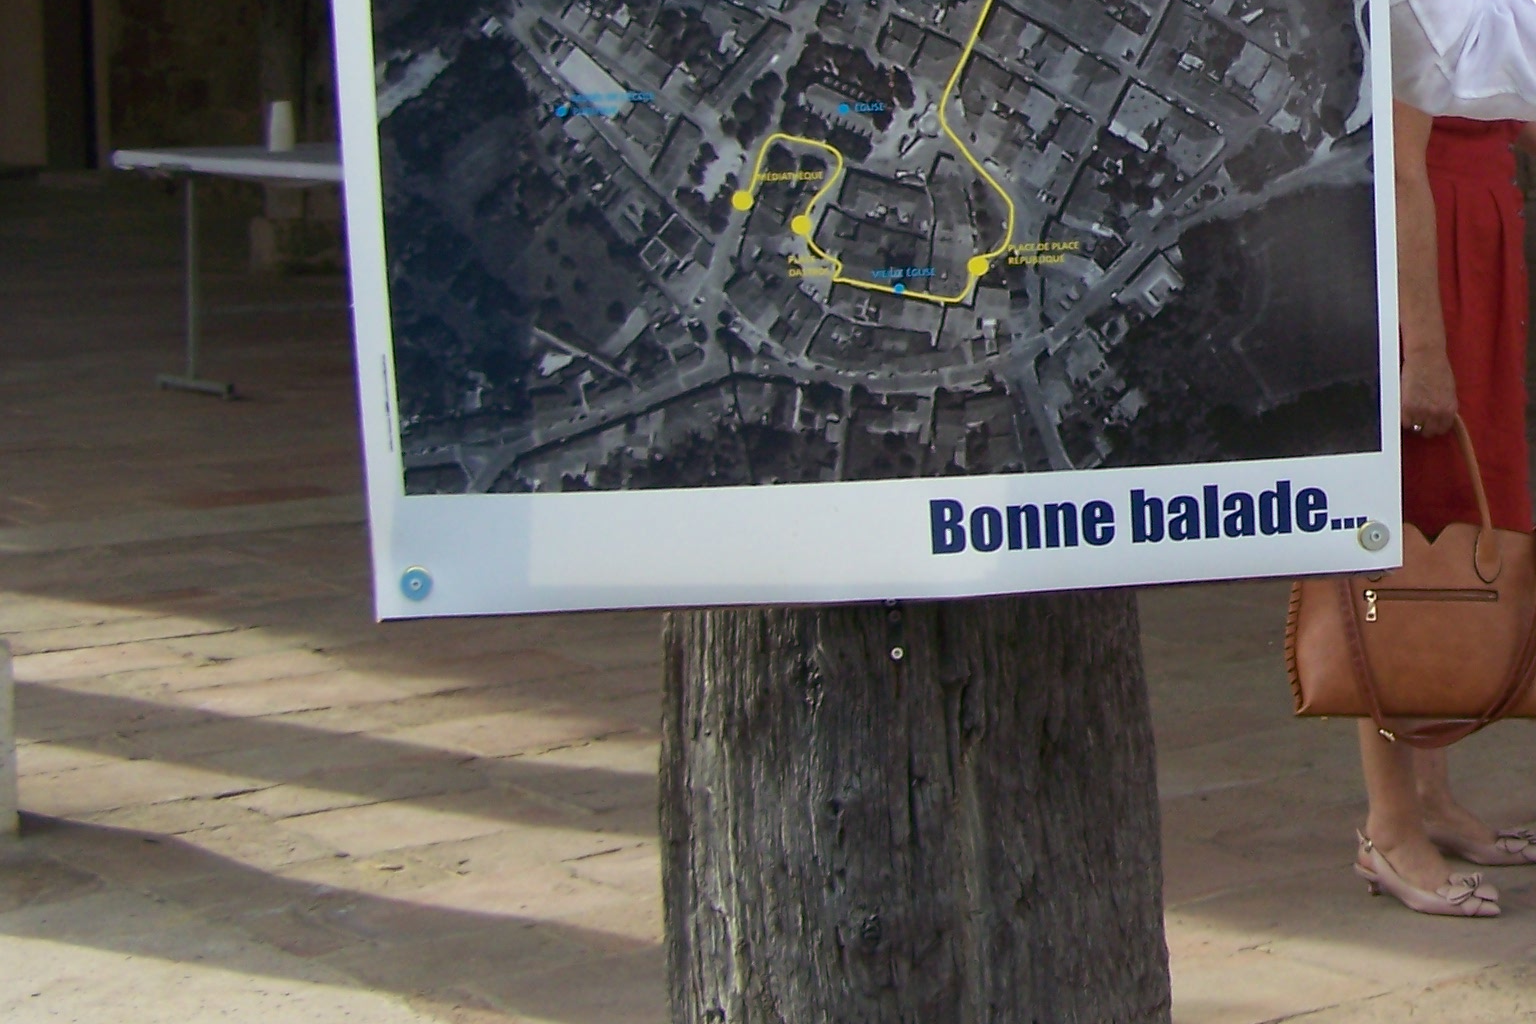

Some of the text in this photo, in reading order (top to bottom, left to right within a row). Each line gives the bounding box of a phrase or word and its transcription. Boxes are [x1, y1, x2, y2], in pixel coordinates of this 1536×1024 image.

[1007, 241, 1079, 252] PLACE DE PLACE
[930, 481, 1368, 555] Bonne balade...
